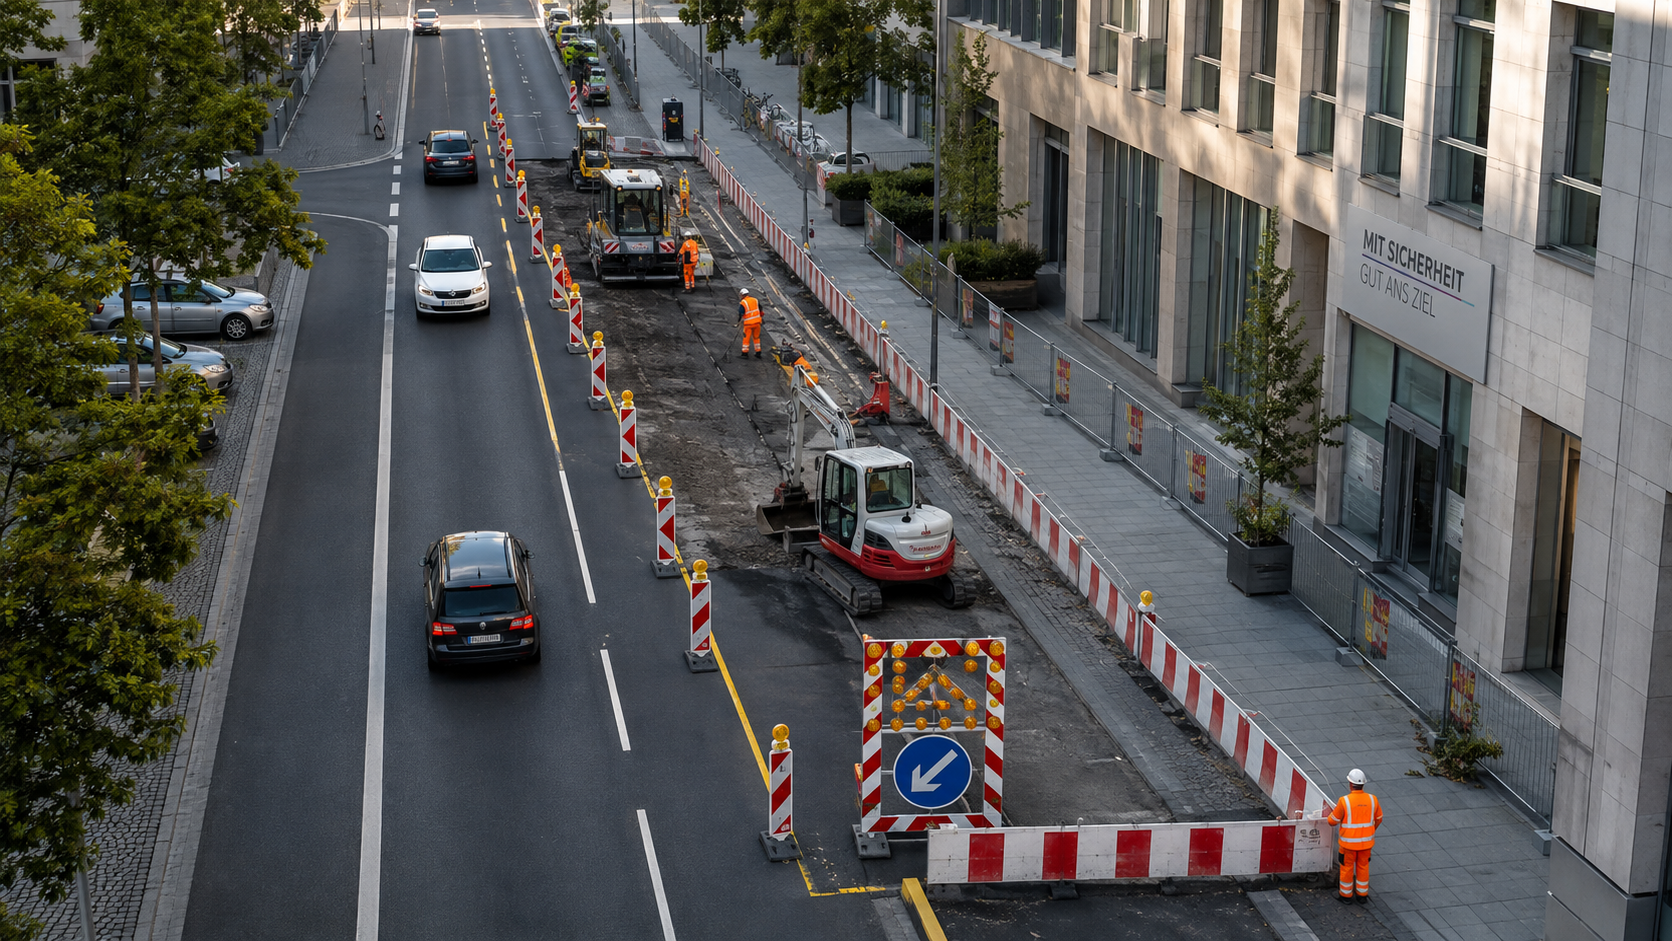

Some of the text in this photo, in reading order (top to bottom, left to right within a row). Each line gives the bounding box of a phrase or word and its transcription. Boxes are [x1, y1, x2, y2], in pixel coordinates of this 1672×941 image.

[1360, 263, 1436, 318] GUT ANS ZIEL
[1363, 229, 1465, 293] MIT SICHERHEIT
